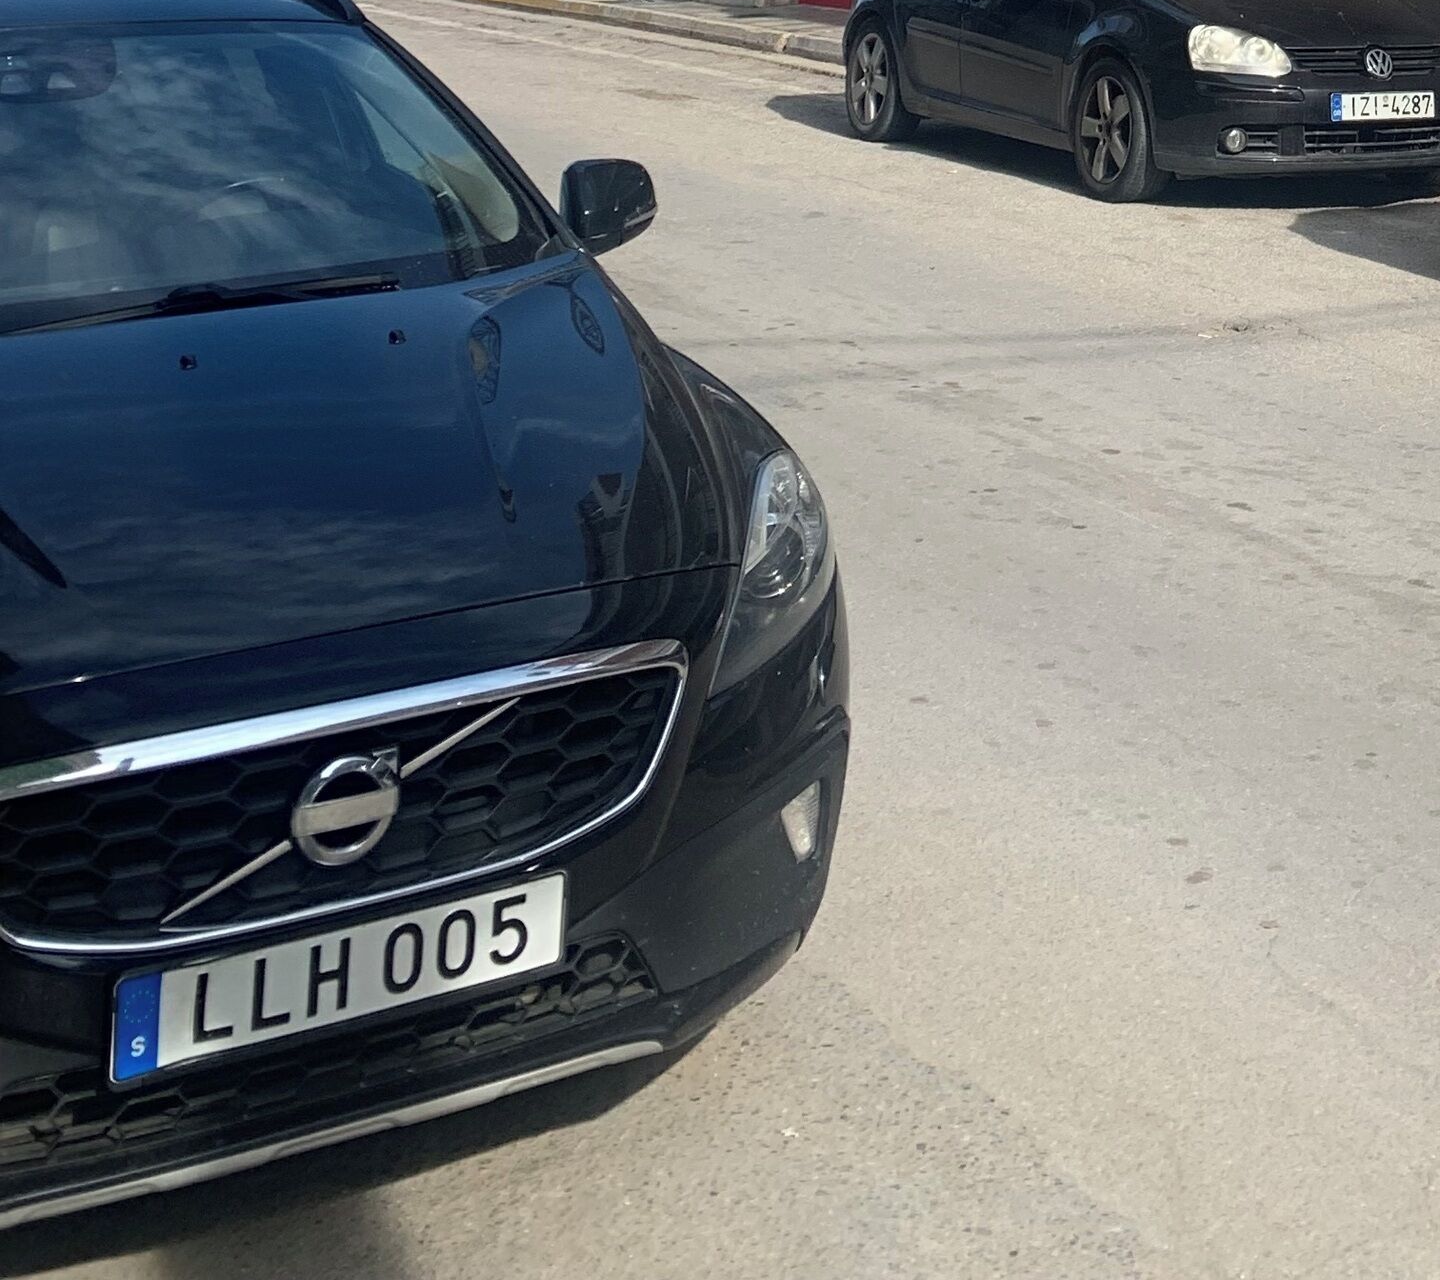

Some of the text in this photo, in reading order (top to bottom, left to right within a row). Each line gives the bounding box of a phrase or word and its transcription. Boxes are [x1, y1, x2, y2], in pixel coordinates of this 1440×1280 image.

[130, 893, 529, 1058] S LLH 005
